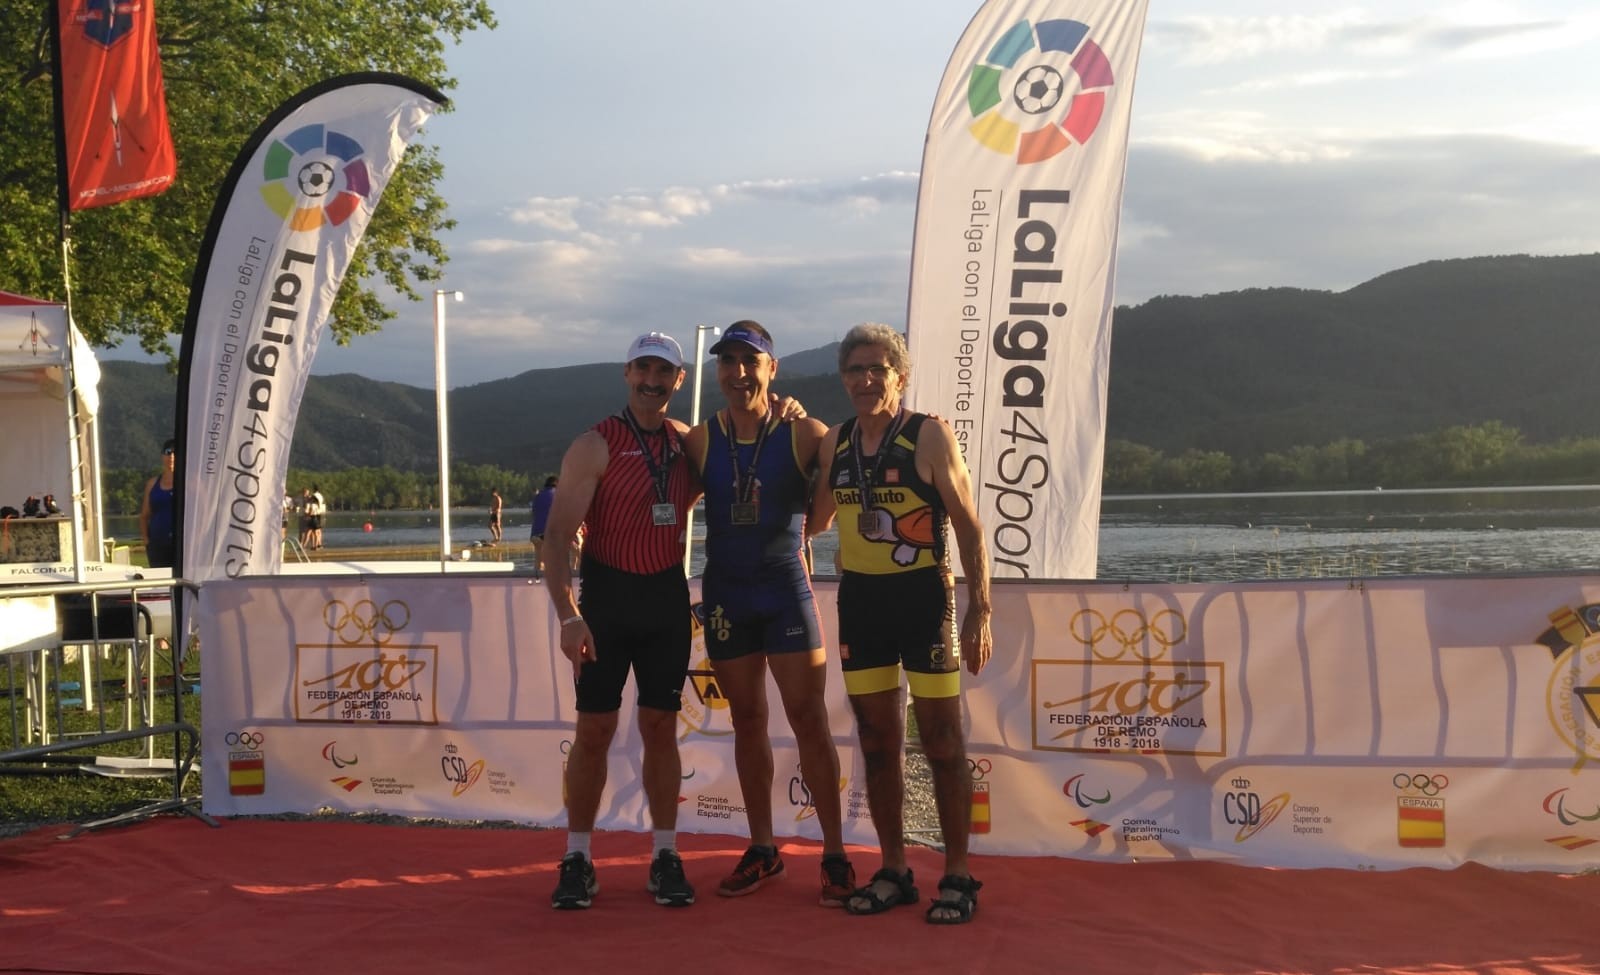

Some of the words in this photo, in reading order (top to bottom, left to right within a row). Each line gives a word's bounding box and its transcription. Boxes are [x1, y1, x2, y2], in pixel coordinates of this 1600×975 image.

[964, 189, 993, 254] LaLiga
[238, 236, 267, 285] LaLiga
[964, 260, 981, 298] con
[227, 289, 247, 319] con
[962, 305, 980, 322] el
[226, 324, 239, 340] el
[213, 342, 238, 408] Deporte
[954, 329, 980, 412] Deporte
[984, 189, 1071, 579] LaLiga4Spor
[225, 249, 316, 579] LaLiga4Sports
[835, 490, 905, 505] Babauto
[11, 567, 57, 575] FALCON
[60, 565, 103, 573] RAING
[308, 690, 370, 700] FEDERACIÓN
[373, 690, 423, 701] ESPAÑOLA
[345, 701, 360, 709] DE
[361, 701, 388, 709] REMO
[341, 710, 361, 719] 1918
[370, 710, 391, 719] 2018
[1050, 713, 1133, 726] FEDERACIÓN
[1137, 715, 1207, 728] ESPAÑOLA
[1098, 726, 1115, 736] DE
[1118, 726, 1157, 737] REMO
[1094, 737, 1121, 748] 1918
[1132, 738, 1160, 749] 2018
[441, 756, 468, 783] CSD
[697, 810, 732, 820] Español
[1223, 791, 1261, 826] CSD
[1124, 833, 1163, 842] Español
